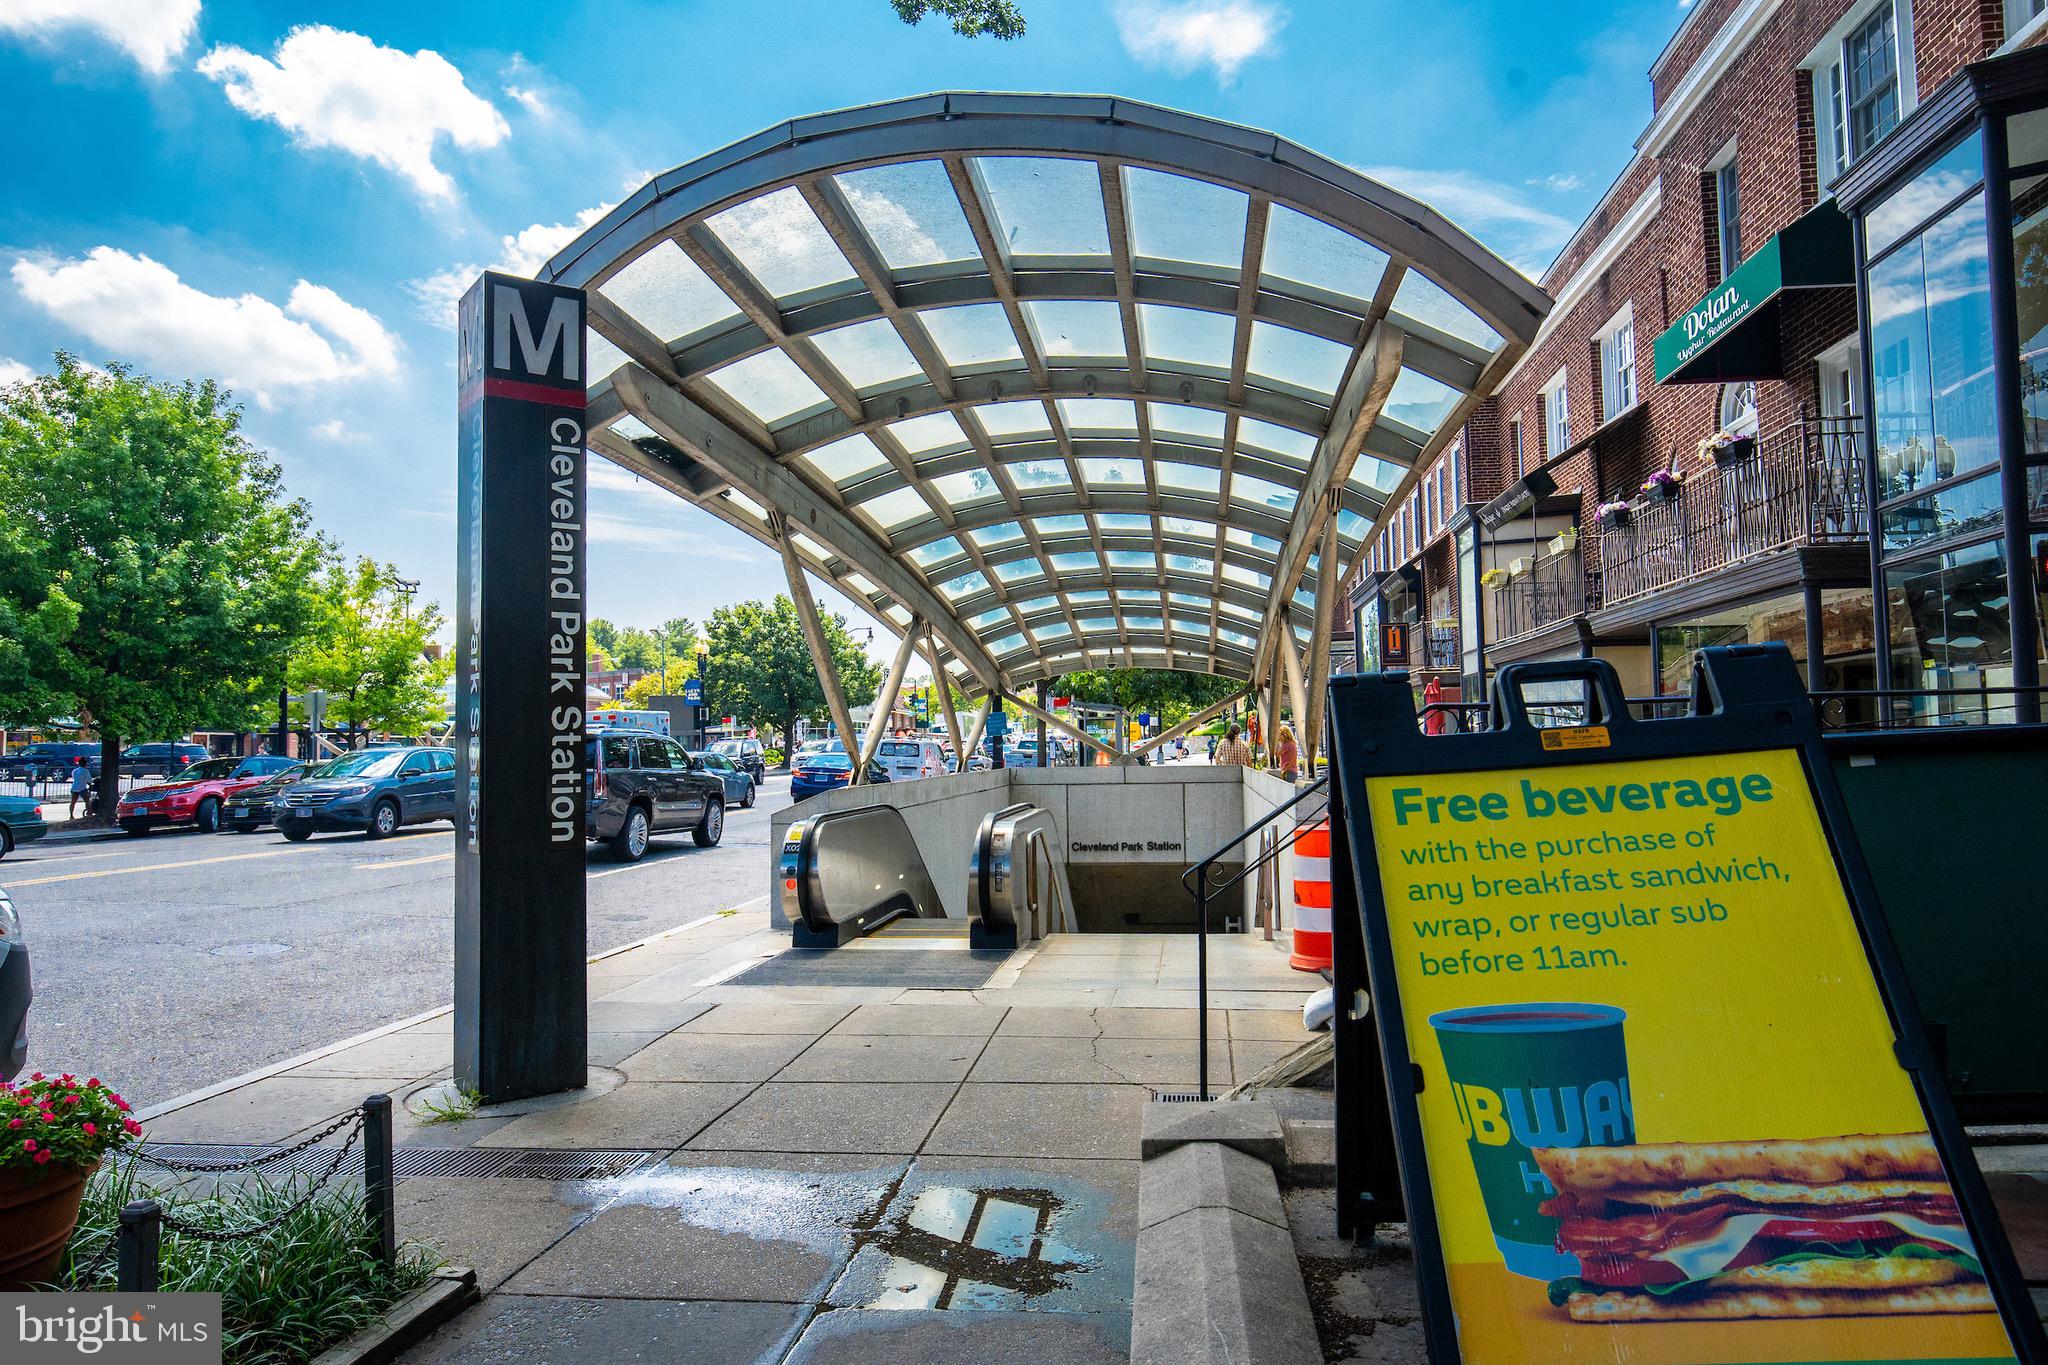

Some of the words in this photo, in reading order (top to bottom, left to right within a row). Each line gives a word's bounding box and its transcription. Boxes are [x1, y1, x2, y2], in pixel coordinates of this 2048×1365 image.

[493, 284, 580, 381] M
[1677, 335, 1706, 361] Uyghur
[1707, 299, 1751, 338] Restaurant
[1683, 286, 1740, 341] Dolan
[550, 417, 582, 600] Cleveland
[469, 613, 480, 693] Park
[550, 611, 581, 693] Park
[468, 706, 480, 845] Station
[550, 706, 583, 842] Station
[1391, 787, 1510, 826] Free
[1520, 772, 1774, 816] beverage
[1071, 841, 1119, 852] Cleveland
[1121, 842, 1144, 852] Park
[1146, 841, 1182, 852] Station
[1400, 838, 1468, 866] with
[1475, 836, 1527, 862] the
[1535, 828, 1677, 864] purchase
[1685, 822, 1717, 848] of
[1407, 880, 1464, 905] any
[1471, 866, 1627, 900] breakfast
[1630, 855, 1792, 889] sandwich,
[1412, 915, 1502, 941] wrap,
[1508, 912, 1541, 934] or
[1549, 902, 1661, 936] regular
[1670, 898, 1729, 925] sub
[1418, 947, 1525, 977] before
[1531, 943, 1629, 971] 11am.
